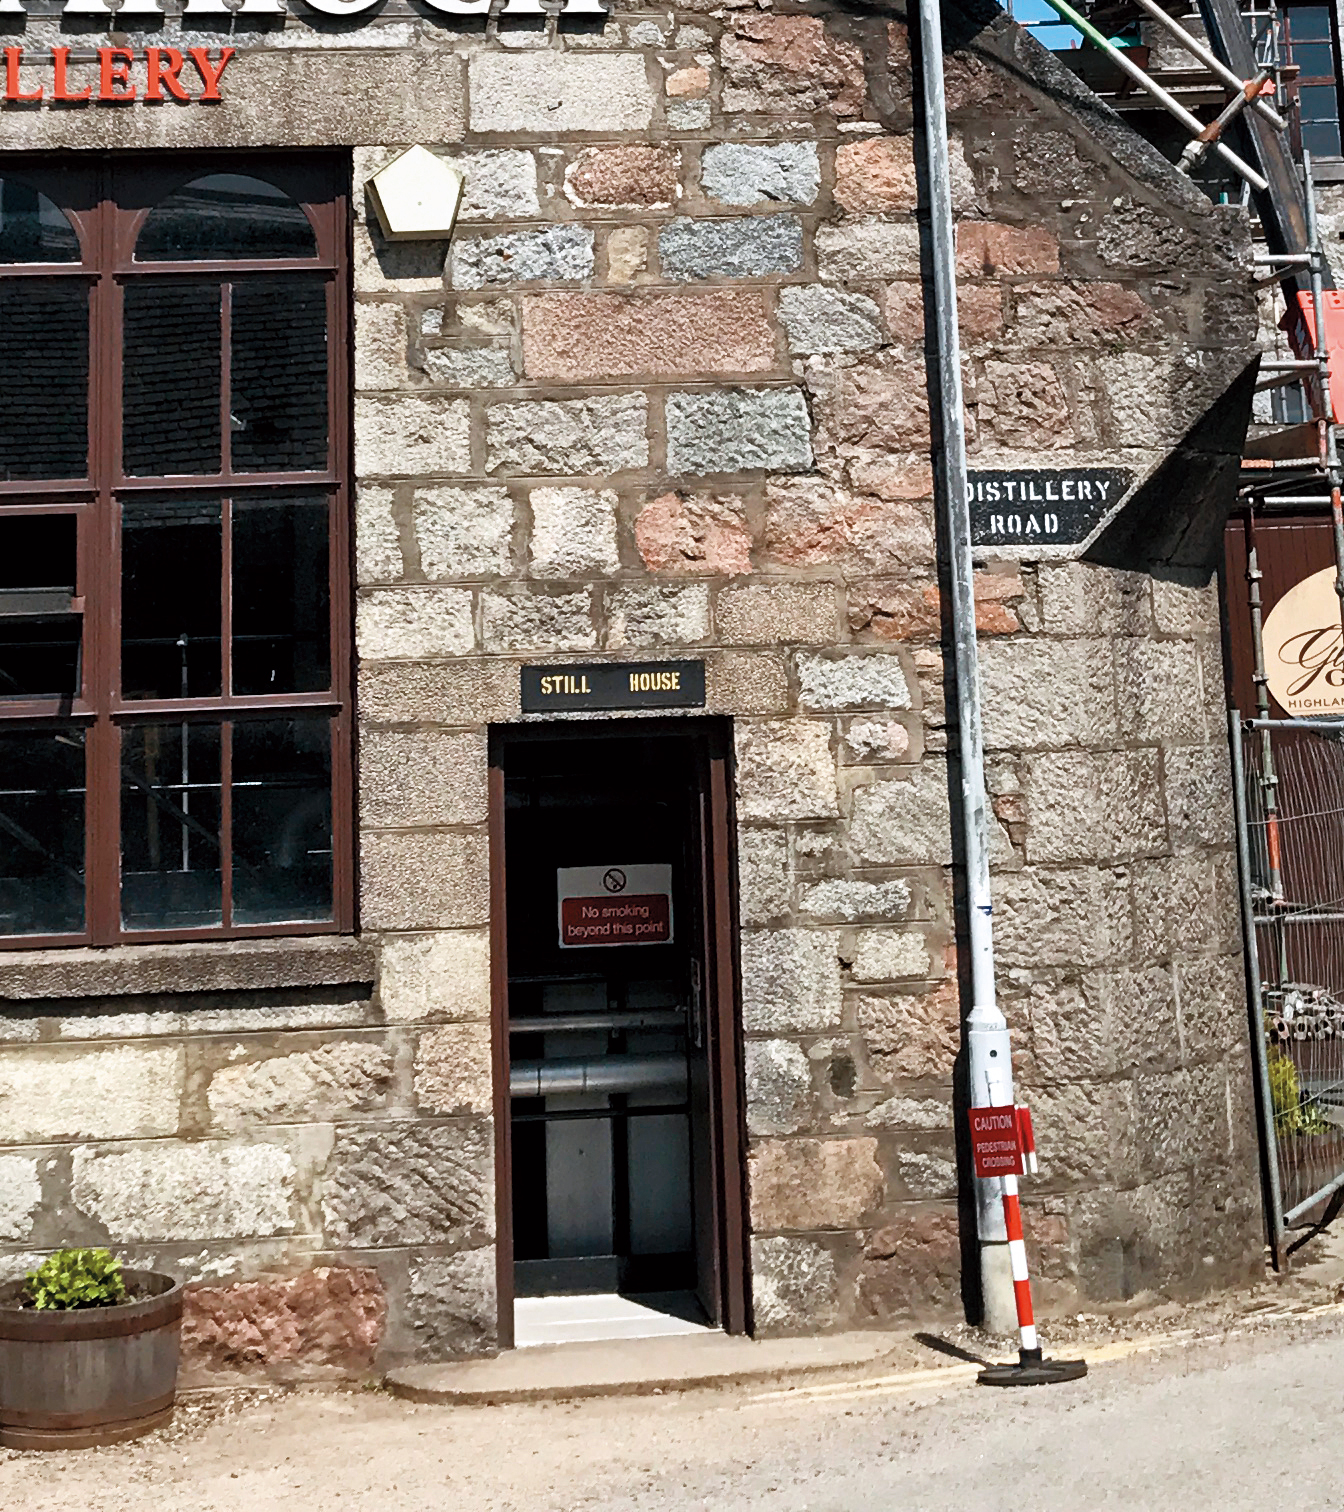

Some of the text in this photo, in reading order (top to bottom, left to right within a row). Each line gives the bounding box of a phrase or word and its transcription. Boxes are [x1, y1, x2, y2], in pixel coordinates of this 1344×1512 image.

[990, 513, 1059, 534] ROAD
[541, 672, 681, 694] STILL HOUSE
[582, 905, 649, 918] No smoking
[567, 921, 664, 938] beyond this point
[975, 1115, 1012, 1130] CAUTION
